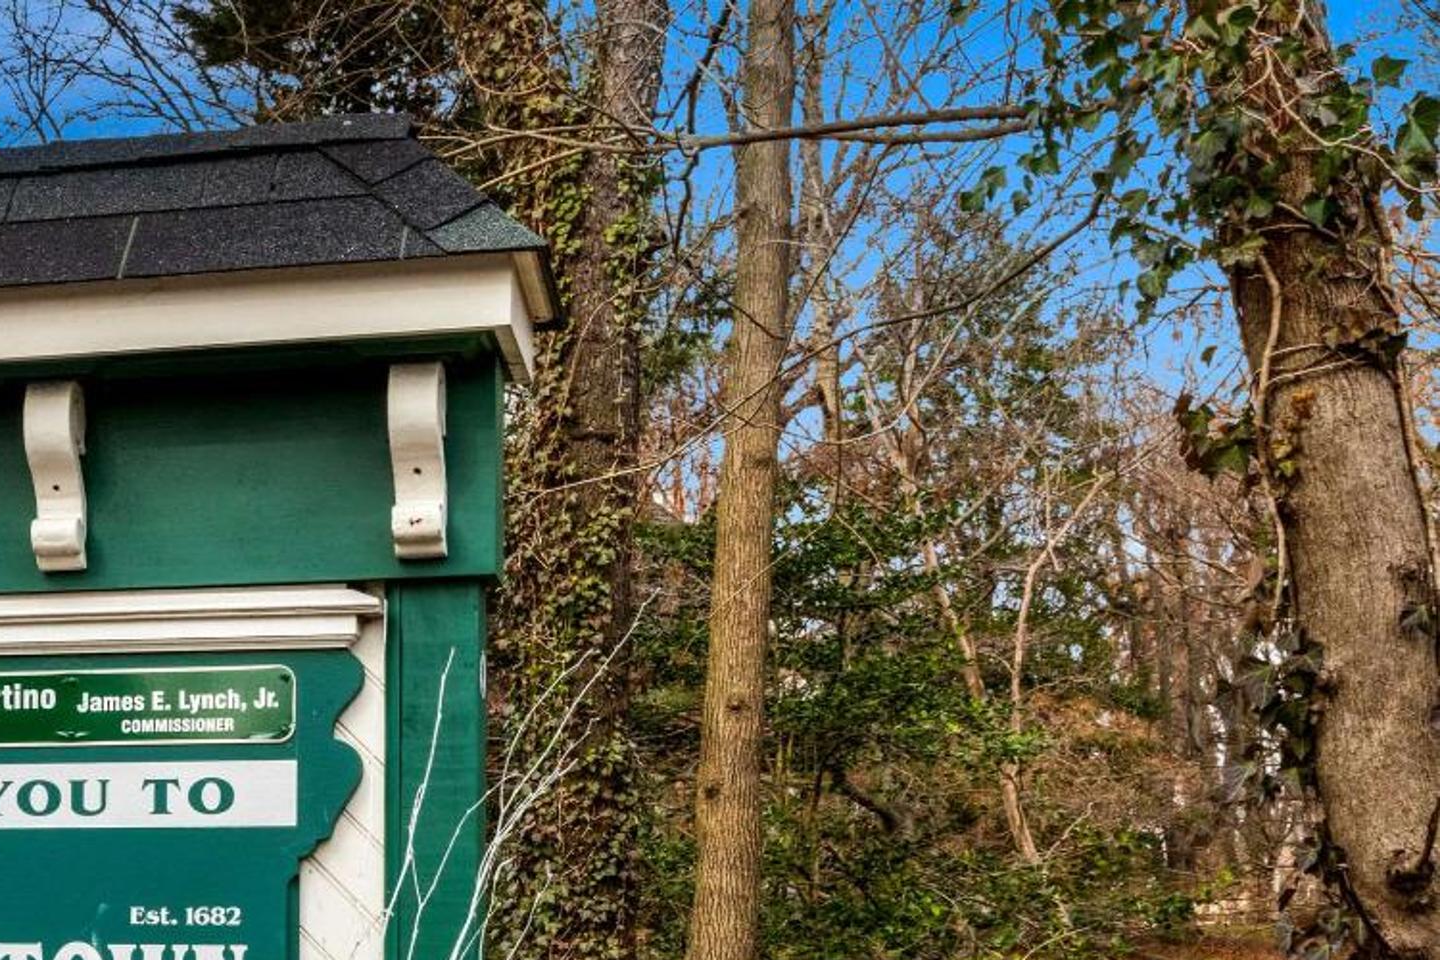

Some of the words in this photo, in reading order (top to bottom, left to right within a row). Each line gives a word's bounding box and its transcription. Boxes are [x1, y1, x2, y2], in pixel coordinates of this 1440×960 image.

[76, 691, 145, 713] James
[151, 691, 172, 711] E.
[178, 689, 248, 713] Lynch,
[253, 687, 280, 709] Jr.
[121, 717, 235, 734] COMMISSIONER
[142, 776, 236, 815] TO
[129, 907, 177, 926] Est.
[185, 905, 241, 926] 1682
